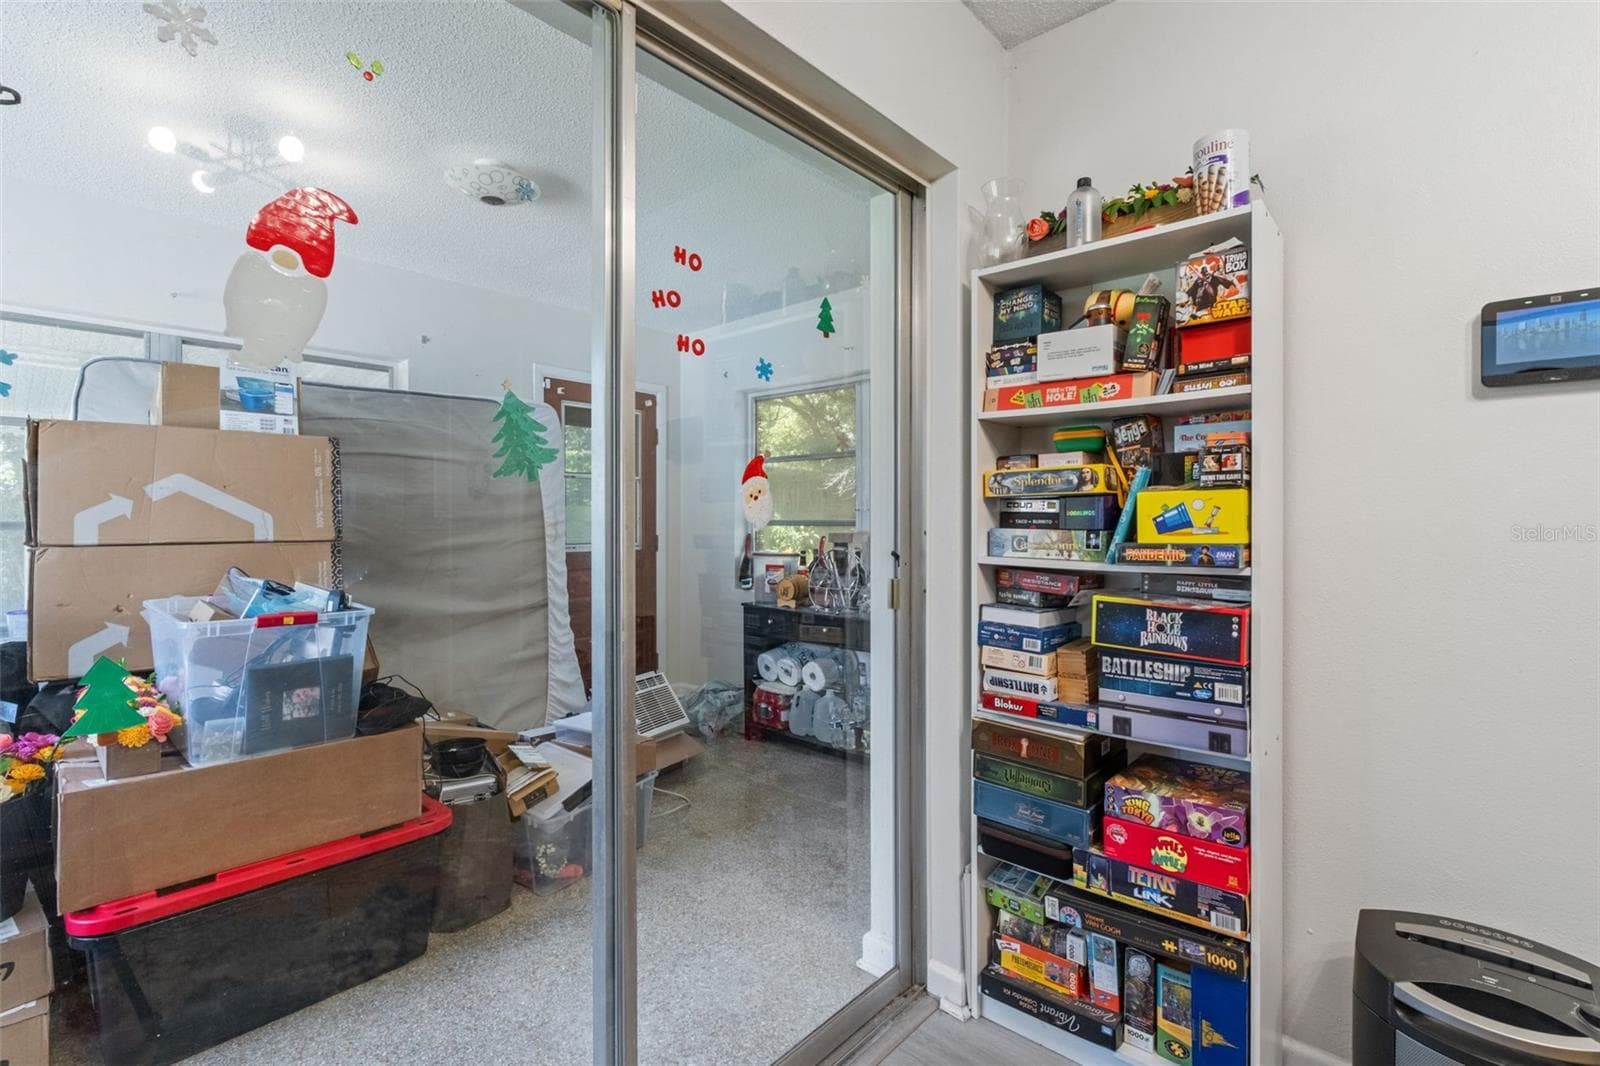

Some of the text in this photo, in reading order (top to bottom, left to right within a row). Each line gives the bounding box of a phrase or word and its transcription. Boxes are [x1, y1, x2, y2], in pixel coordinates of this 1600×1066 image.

[673, 245, 702, 272] HO
[1226, 251, 1248, 263] TRIVIA
[1225, 260, 1246, 274] BOX
[651, 289, 681, 308] HO
[1000, 294, 1035, 309] CHANGE
[1000, 301, 1034, 314] MY MIND
[1213, 299, 1248, 311] STAR
[1212, 306, 1249, 318] WARS
[677, 334, 705, 356] HO
[1046, 391, 1077, 402] HOLE!
[1114, 420, 1147, 444] Jenga
[1014, 473, 1065, 491] Splendor
[1125, 548, 1185, 561] PANDEMIC
[1176, 585, 1215, 594] DINOSAUR
[1146, 608, 1183, 624] BLACK
[1147, 621, 1181, 635] HOLE
[1140, 631, 1188, 652] RAINBOWS
[1102, 656, 1191, 682] BATTLESHIP
[990, 676, 1039, 694] BATTLESHIP
[994, 698, 1023, 711] Blokus
[1125, 799, 1150, 811] KING
[1122, 806, 1155, 825] TOKYO
[1128, 866, 1177, 897] TETRIS
[1134, 887, 1173, 908] LINK
[1085, 918, 1121, 936] VAN GOGH
[1207, 952, 1237, 971] 1000
[1040, 1003, 1080, 1032] Vibrant
